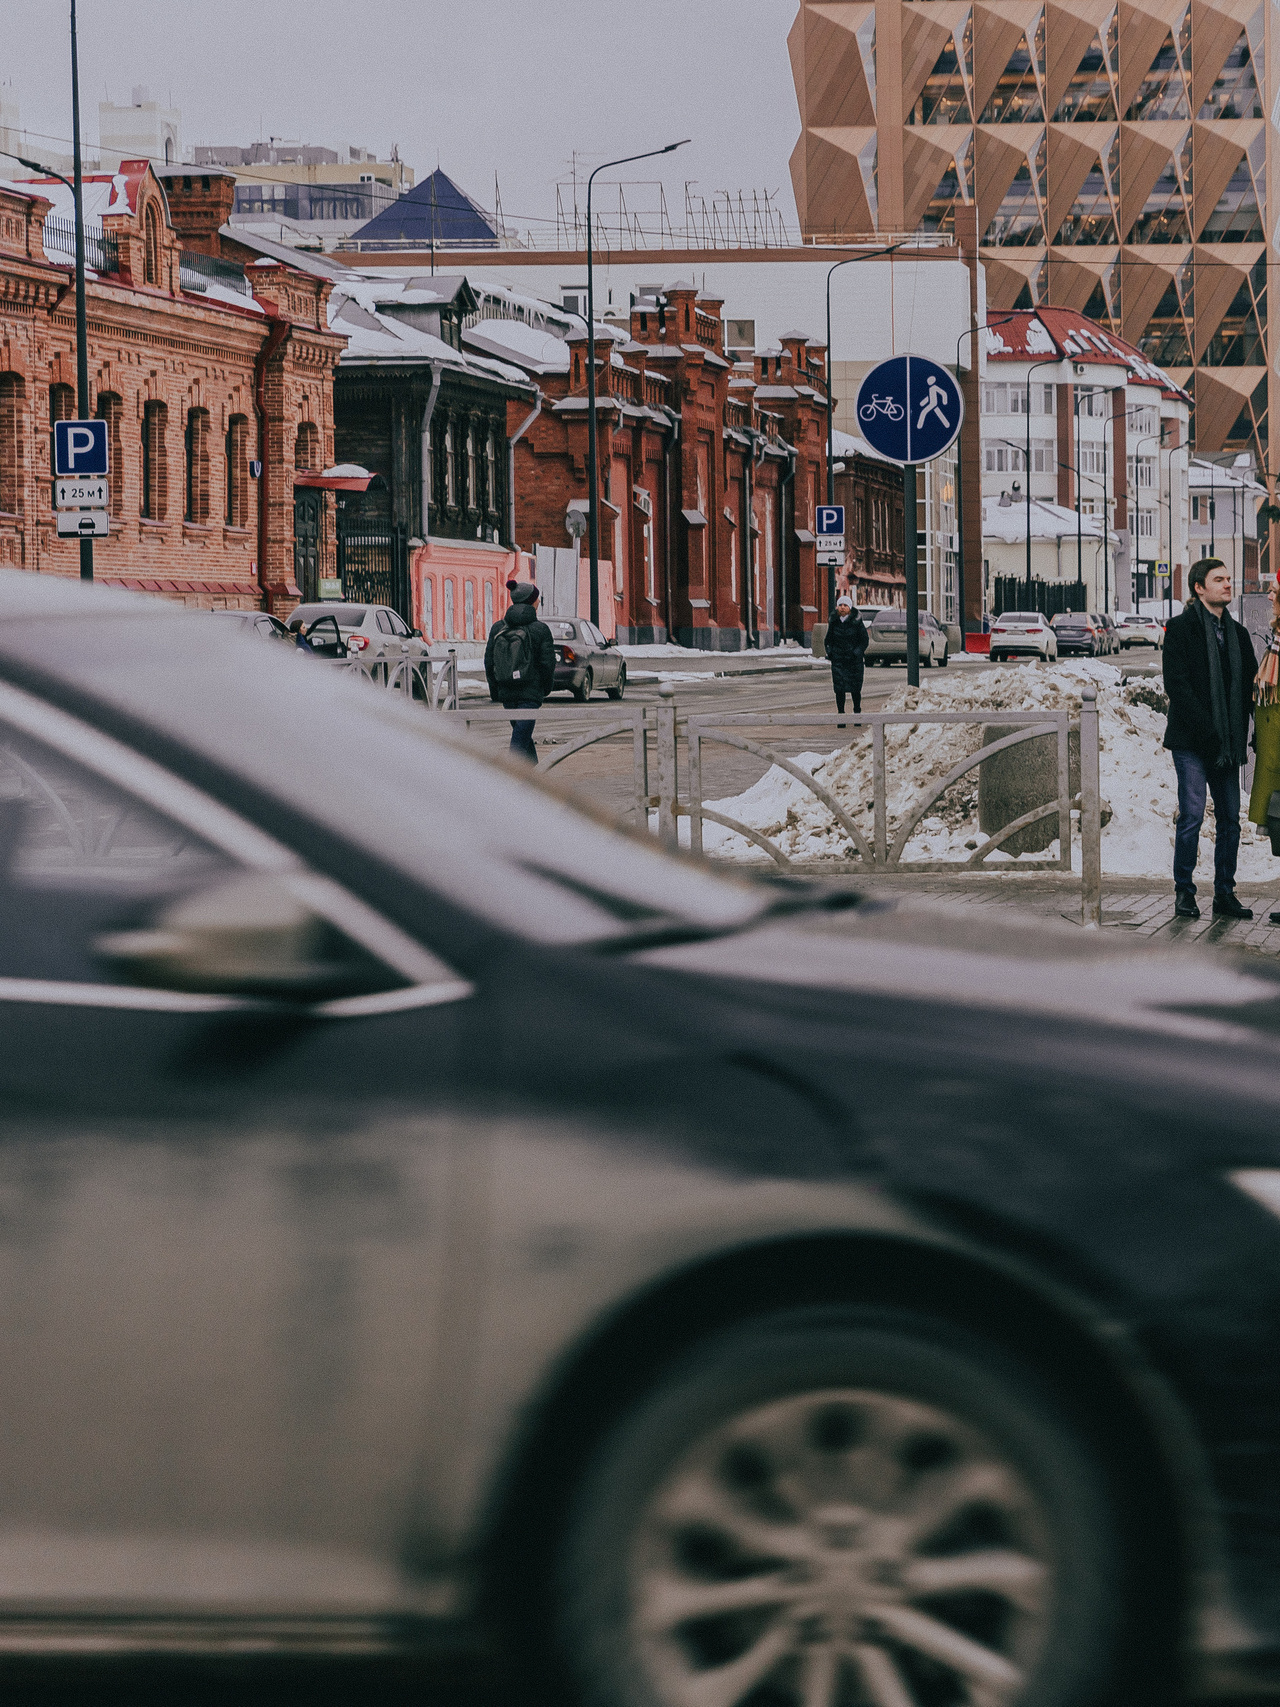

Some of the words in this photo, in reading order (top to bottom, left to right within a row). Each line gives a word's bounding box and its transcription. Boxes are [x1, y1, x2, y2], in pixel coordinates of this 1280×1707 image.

[67, 427, 95, 469] P
[71, 488, 85, 498] 25
[823, 510, 837, 531] P
